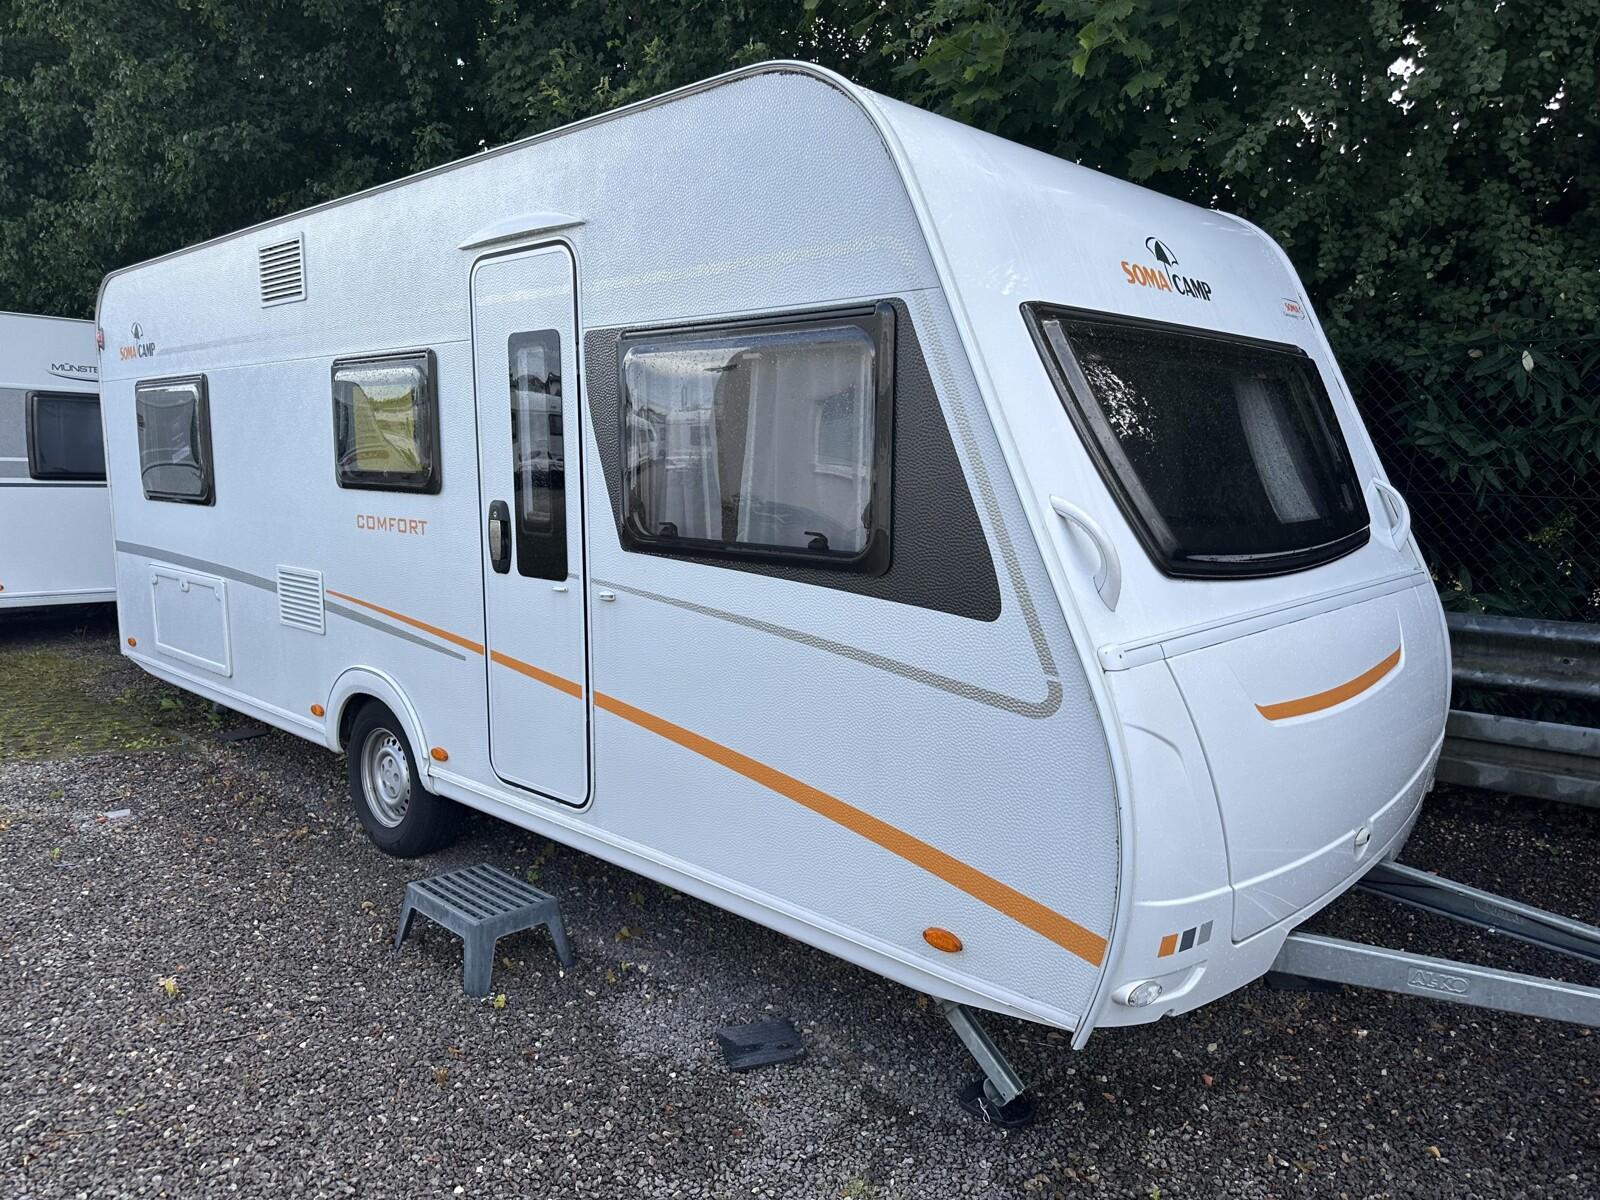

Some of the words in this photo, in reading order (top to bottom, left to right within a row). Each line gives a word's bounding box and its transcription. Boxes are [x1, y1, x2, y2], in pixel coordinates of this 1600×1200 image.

[1120, 261, 1173, 293] SOMA
[1172, 274, 1212, 302] CAMP
[120, 346, 137, 361] SOMA
[138, 342, 156, 358] CAMP
[356, 514, 428, 536] COMFORT
